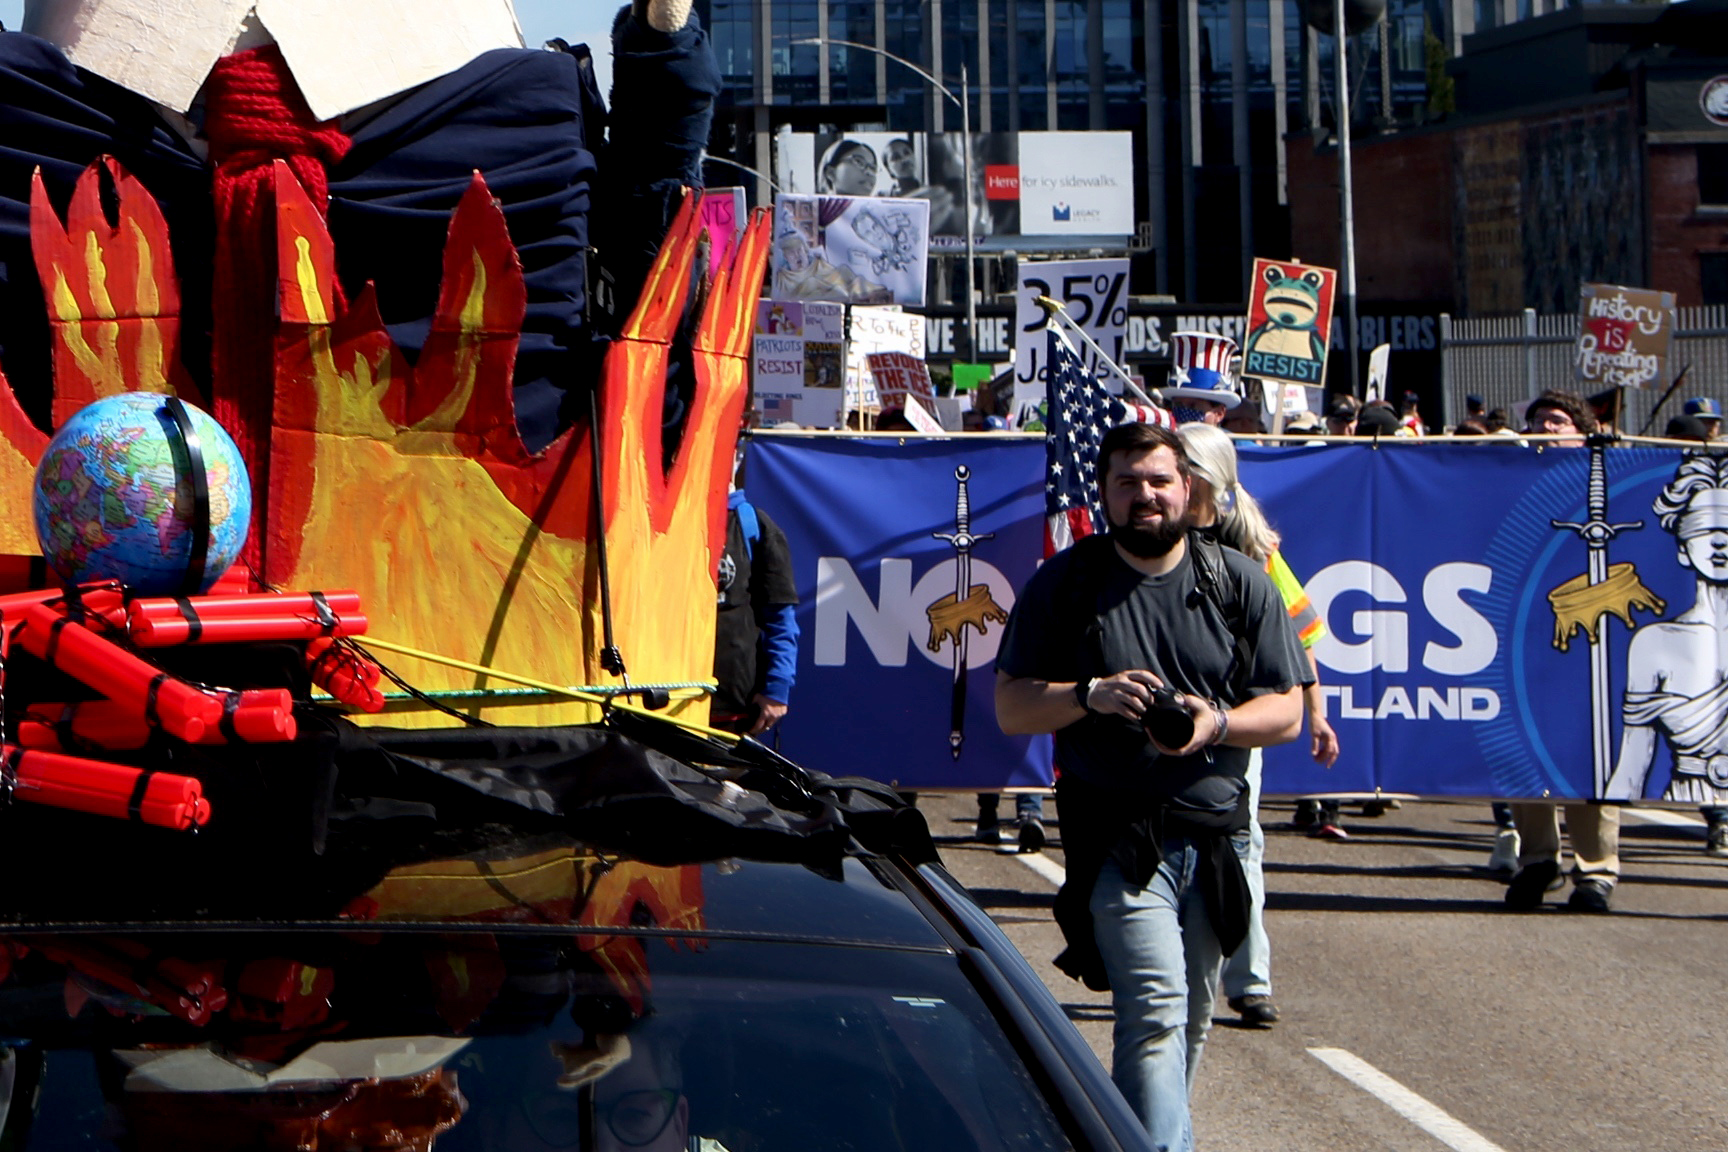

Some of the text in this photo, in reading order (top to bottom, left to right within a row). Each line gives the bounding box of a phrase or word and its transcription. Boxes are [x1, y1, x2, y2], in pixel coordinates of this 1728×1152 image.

[988, 174, 1118, 191] Here for icy sidewalks.
[1589, 293, 1662, 335] History
[756, 339, 802, 354] PATRIOTS
[1605, 323, 1624, 348] is
[758, 358, 802, 375] RESIST
[866, 352, 927, 376] REVOKE
[1248, 352, 1321, 380] RESIST
[1576, 334, 1658, 379] Repeating
[873, 368, 909, 391] THE
[908, 370, 933, 397] ICE
[814, 557, 1016, 670] NO
